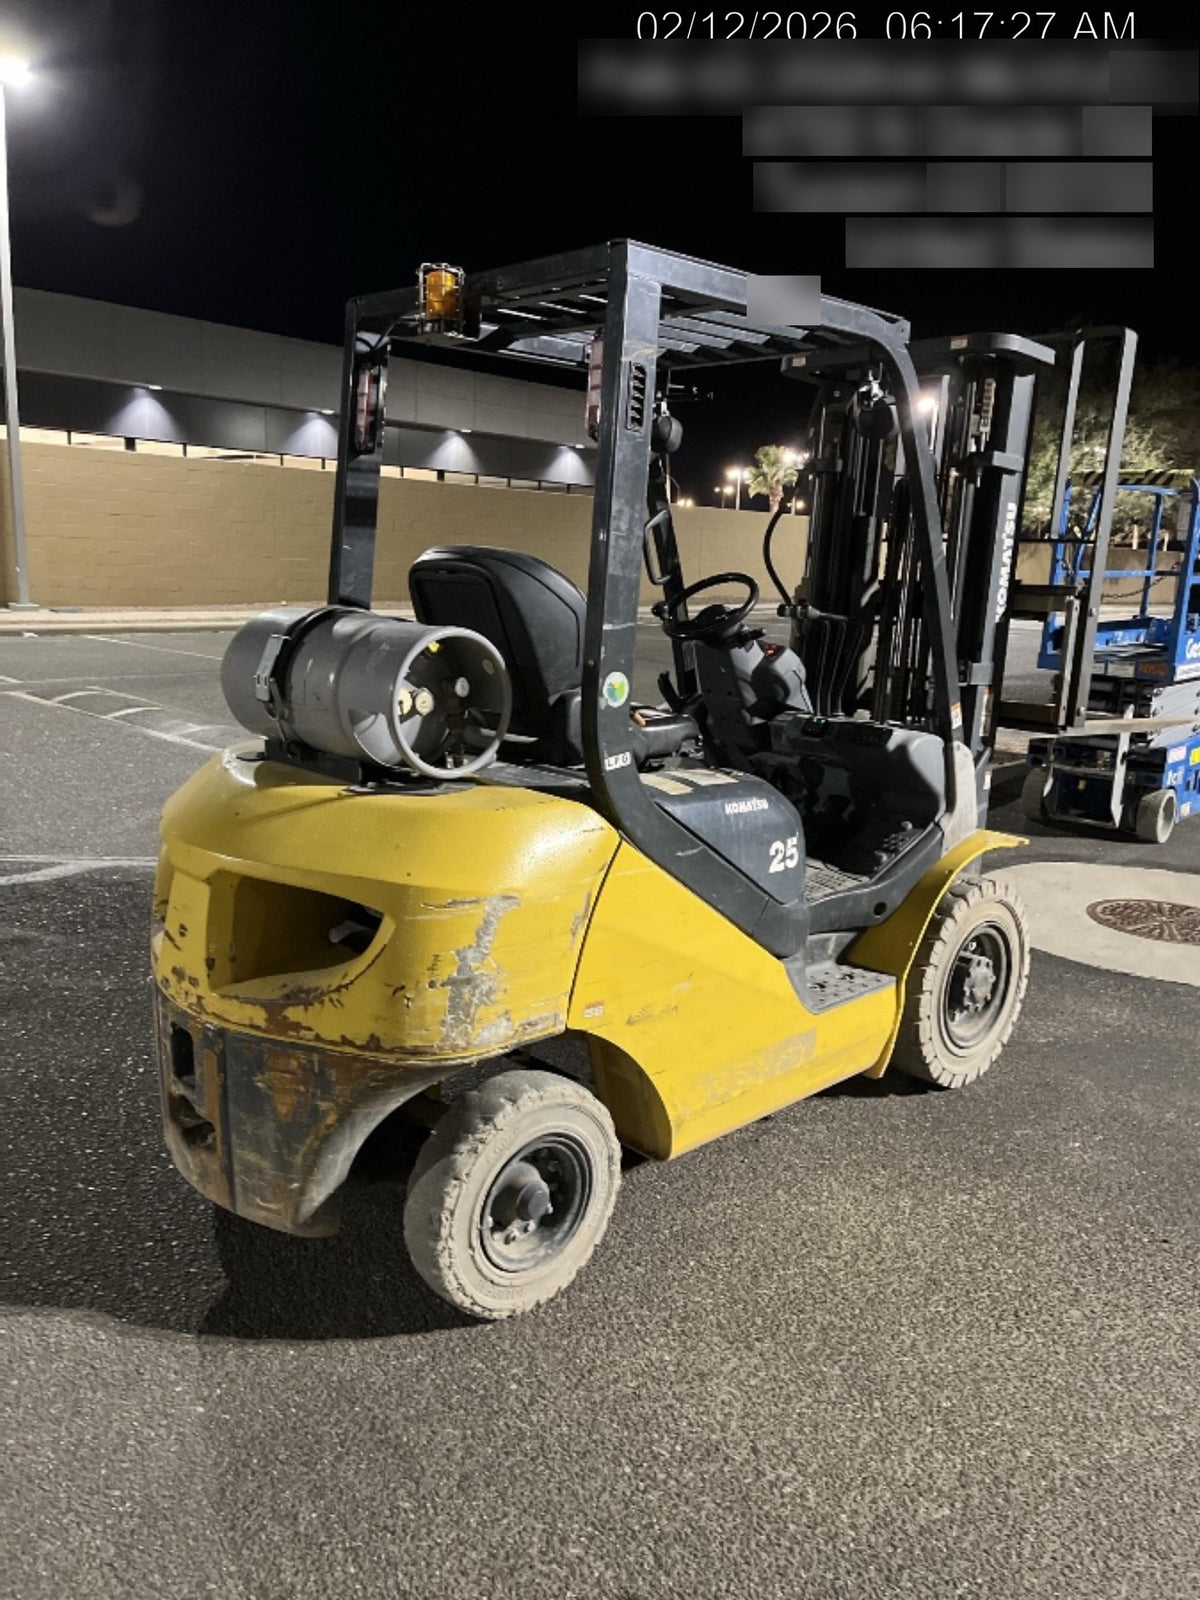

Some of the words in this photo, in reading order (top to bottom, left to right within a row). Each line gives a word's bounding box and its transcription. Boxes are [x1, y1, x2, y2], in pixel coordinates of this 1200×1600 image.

[995, 502, 1018, 623] KOMATSU
[725, 798, 768, 815] KOMATSU
[769, 836, 799, 873] 25
